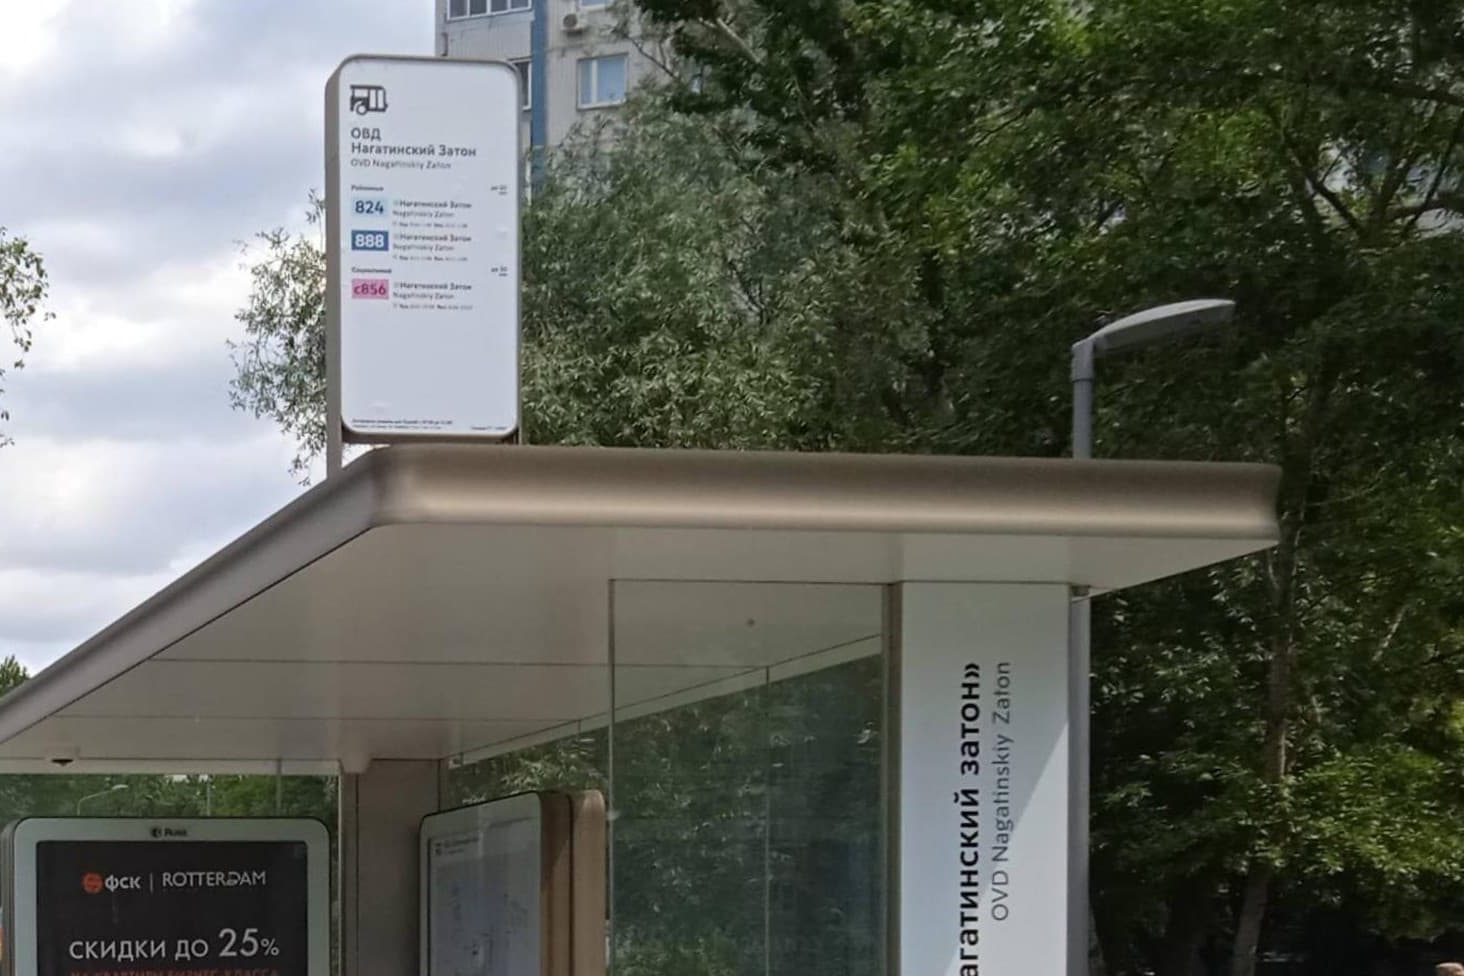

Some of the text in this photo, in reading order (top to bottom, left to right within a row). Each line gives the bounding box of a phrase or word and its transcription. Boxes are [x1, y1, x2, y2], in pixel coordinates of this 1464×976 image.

[350, 127, 381, 141] ОВД
[350, 142, 477, 158] Нагатинский Затон
[350, 159, 371, 168] OVD
[355, 200, 385, 215] 824
[354, 233, 385, 248] 888
[956, 662, 981, 776] затон»
[991, 661, 1015, 921] OVD Nagatinskiy Zaton
[162, 871, 267, 887] ROTTERDAM
[69, 928, 280, 962] СКИДКИ ДО 25%
